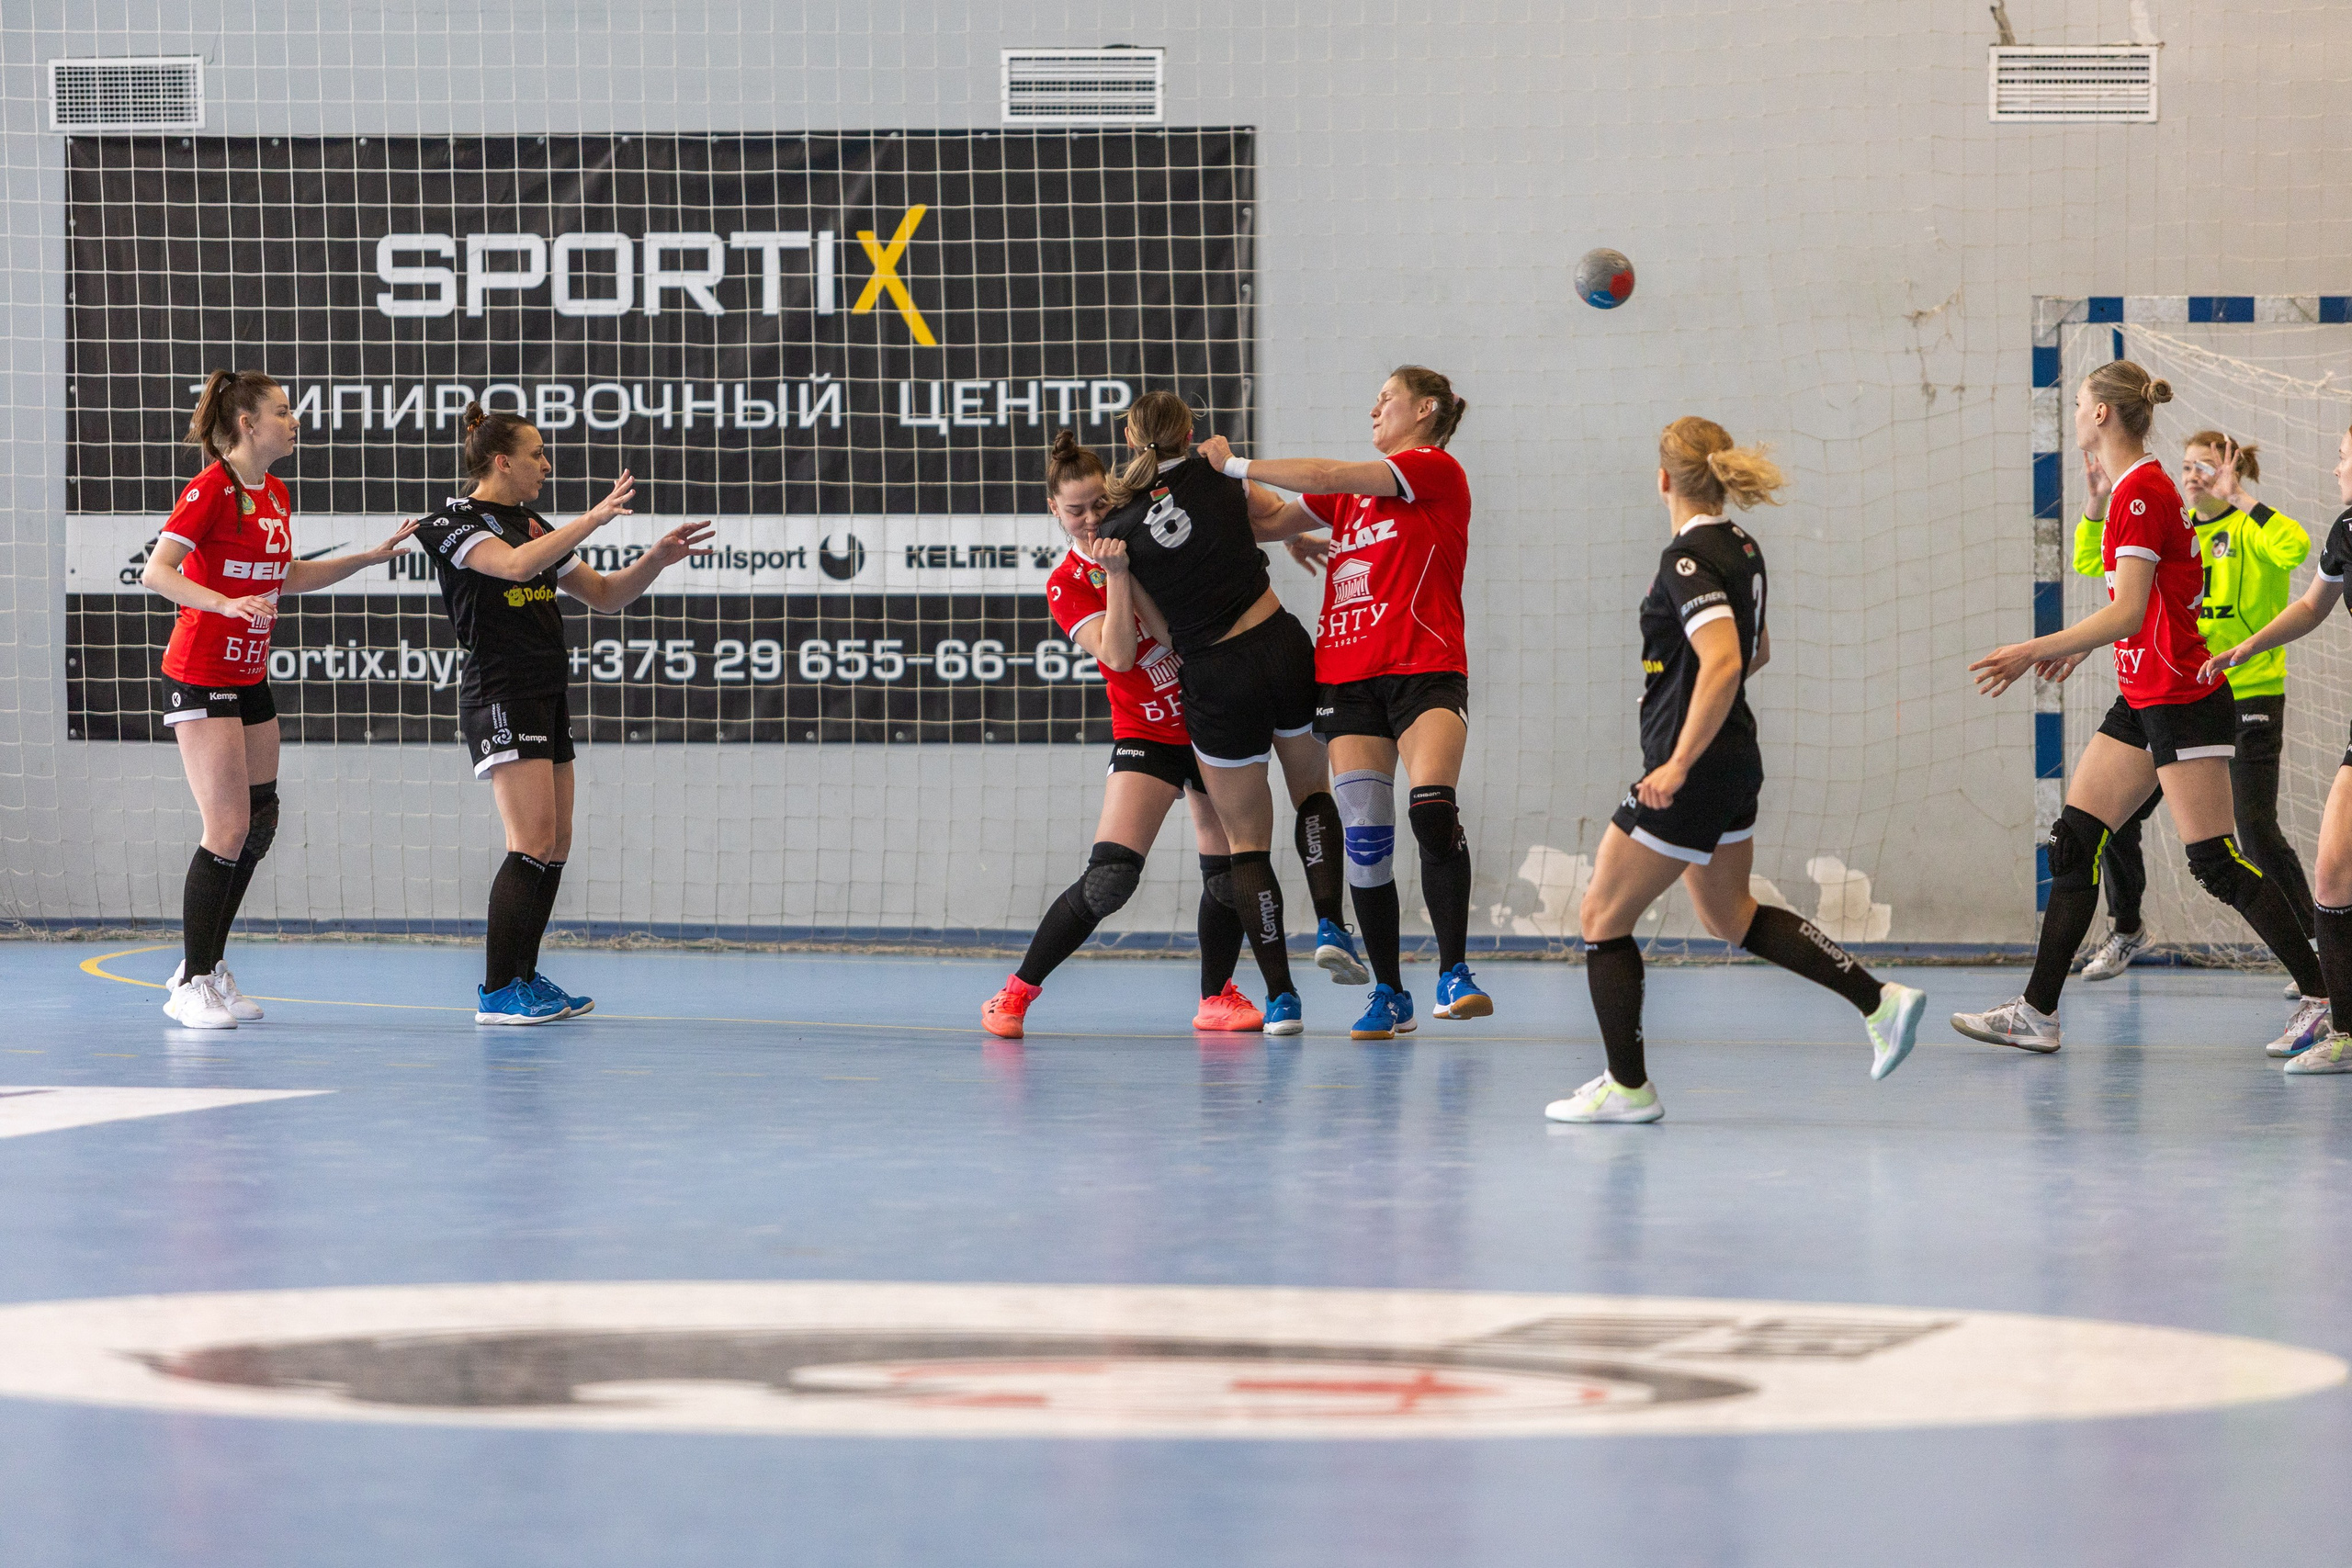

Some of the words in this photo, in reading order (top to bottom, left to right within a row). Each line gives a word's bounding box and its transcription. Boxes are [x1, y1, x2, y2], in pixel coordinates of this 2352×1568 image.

[377, 204, 937, 347] SPORTIX
[189, 374, 842, 430] ИПИРОВОЧНЫЙ
[899, 380, 1132, 435] ЦЕНТР
[258, 517, 290, 554] 23
[222, 559, 290, 581] BEL
[389, 551, 436, 581] PU
[689, 545, 807, 575] uhlsport
[905, 544, 1019, 569] KELME
[569, 640, 696, 681] +375
[713, 640, 782, 681] 29
[209, 692, 237, 702] Kempa
[518, 733, 548, 743] Kempa
[1116, 747, 1145, 758] Kempa
[1306, 815, 1326, 867] Kempa
[1258, 890, 1279, 944] Kempa
[1799, 921, 1854, 974] Kempa
